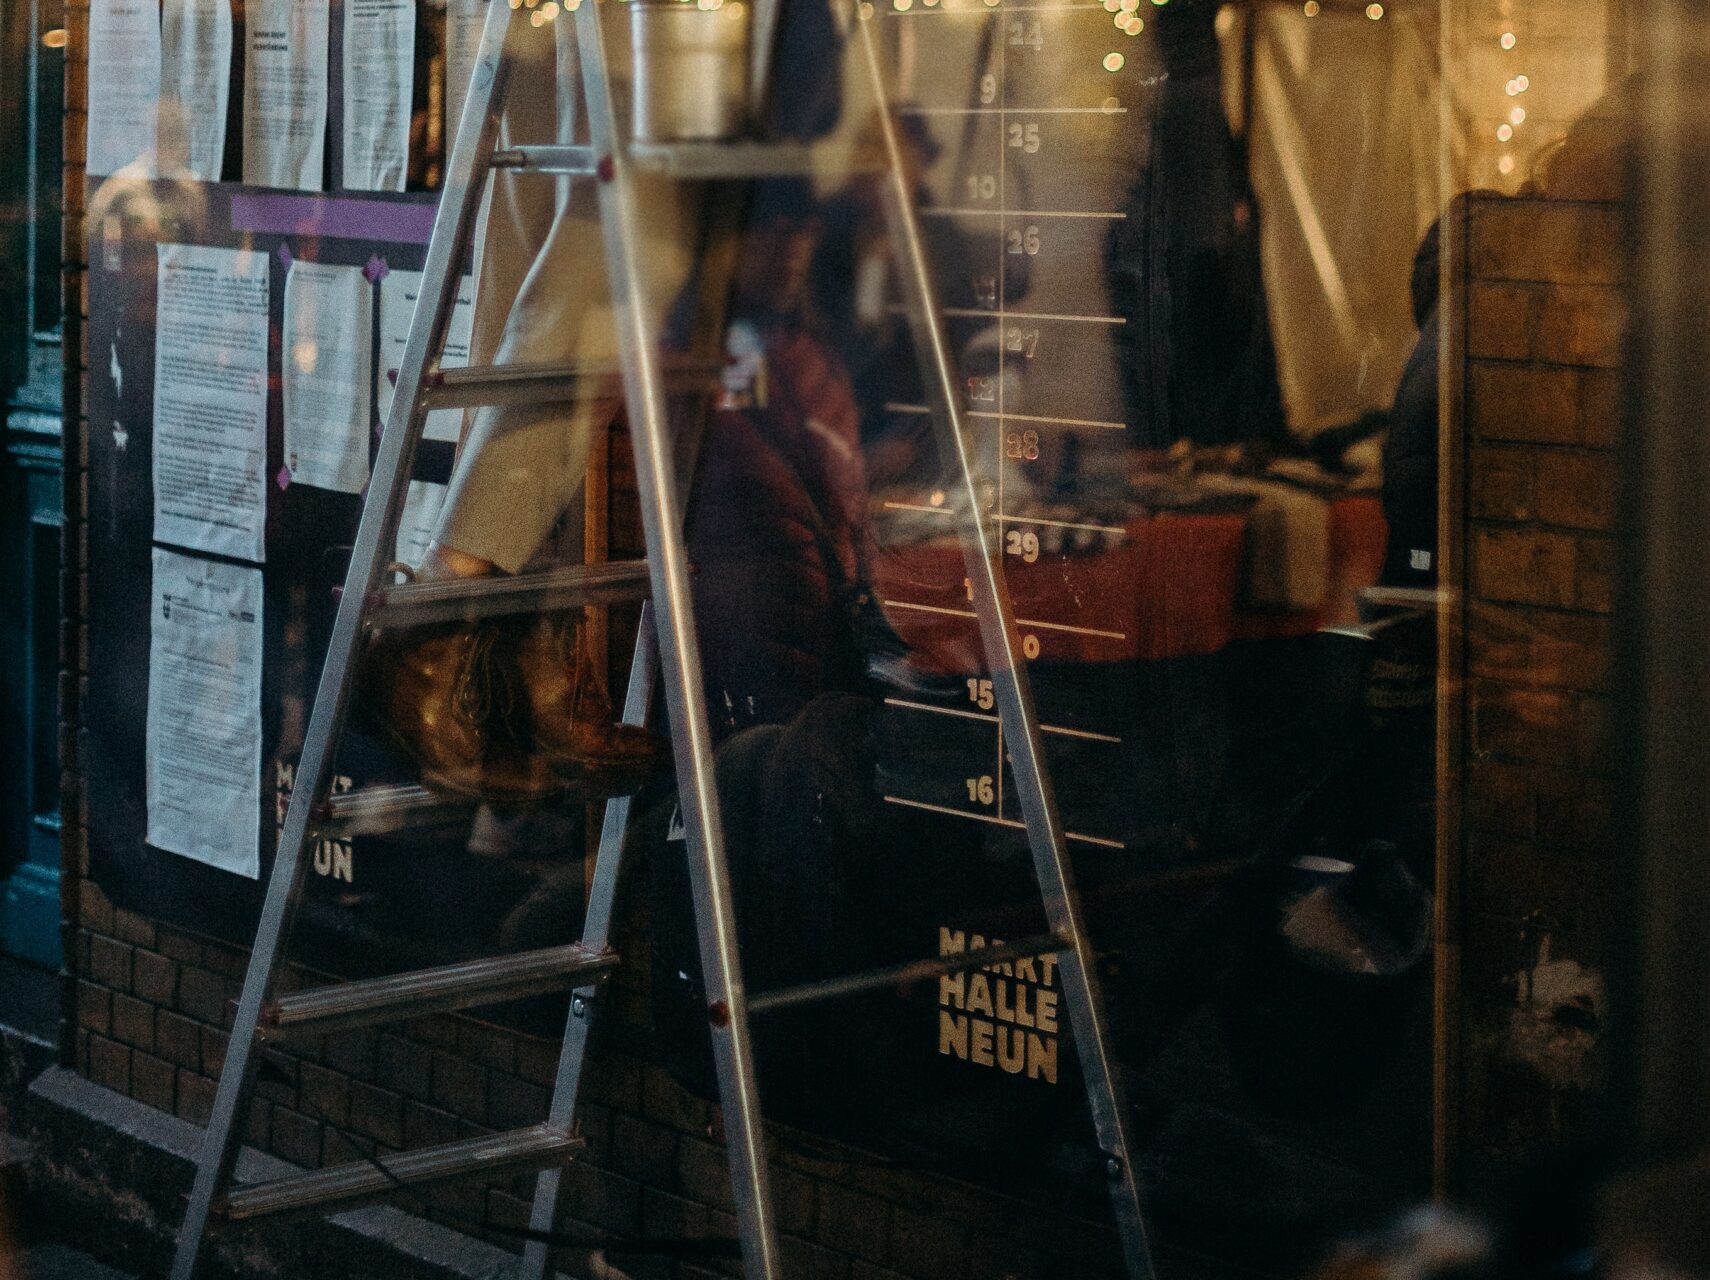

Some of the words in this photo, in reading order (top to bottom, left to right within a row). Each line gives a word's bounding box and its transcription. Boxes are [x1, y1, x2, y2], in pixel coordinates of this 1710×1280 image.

[980, 73, 996, 104] 9
[1008, 122, 1040, 153] 25
[966, 175, 995, 199] 10
[1007, 225, 1040, 255] 26
[1006, 327, 1040, 358] 27
[966, 376, 996, 402] 12
[1006, 429, 1040, 460] 28
[1006, 530, 1040, 564] 29
[966, 678, 995, 710] 15
[966, 774, 995, 806] 16
[939, 971, 1058, 1034] HALLE
[939, 1010, 1058, 1085] NEUN
